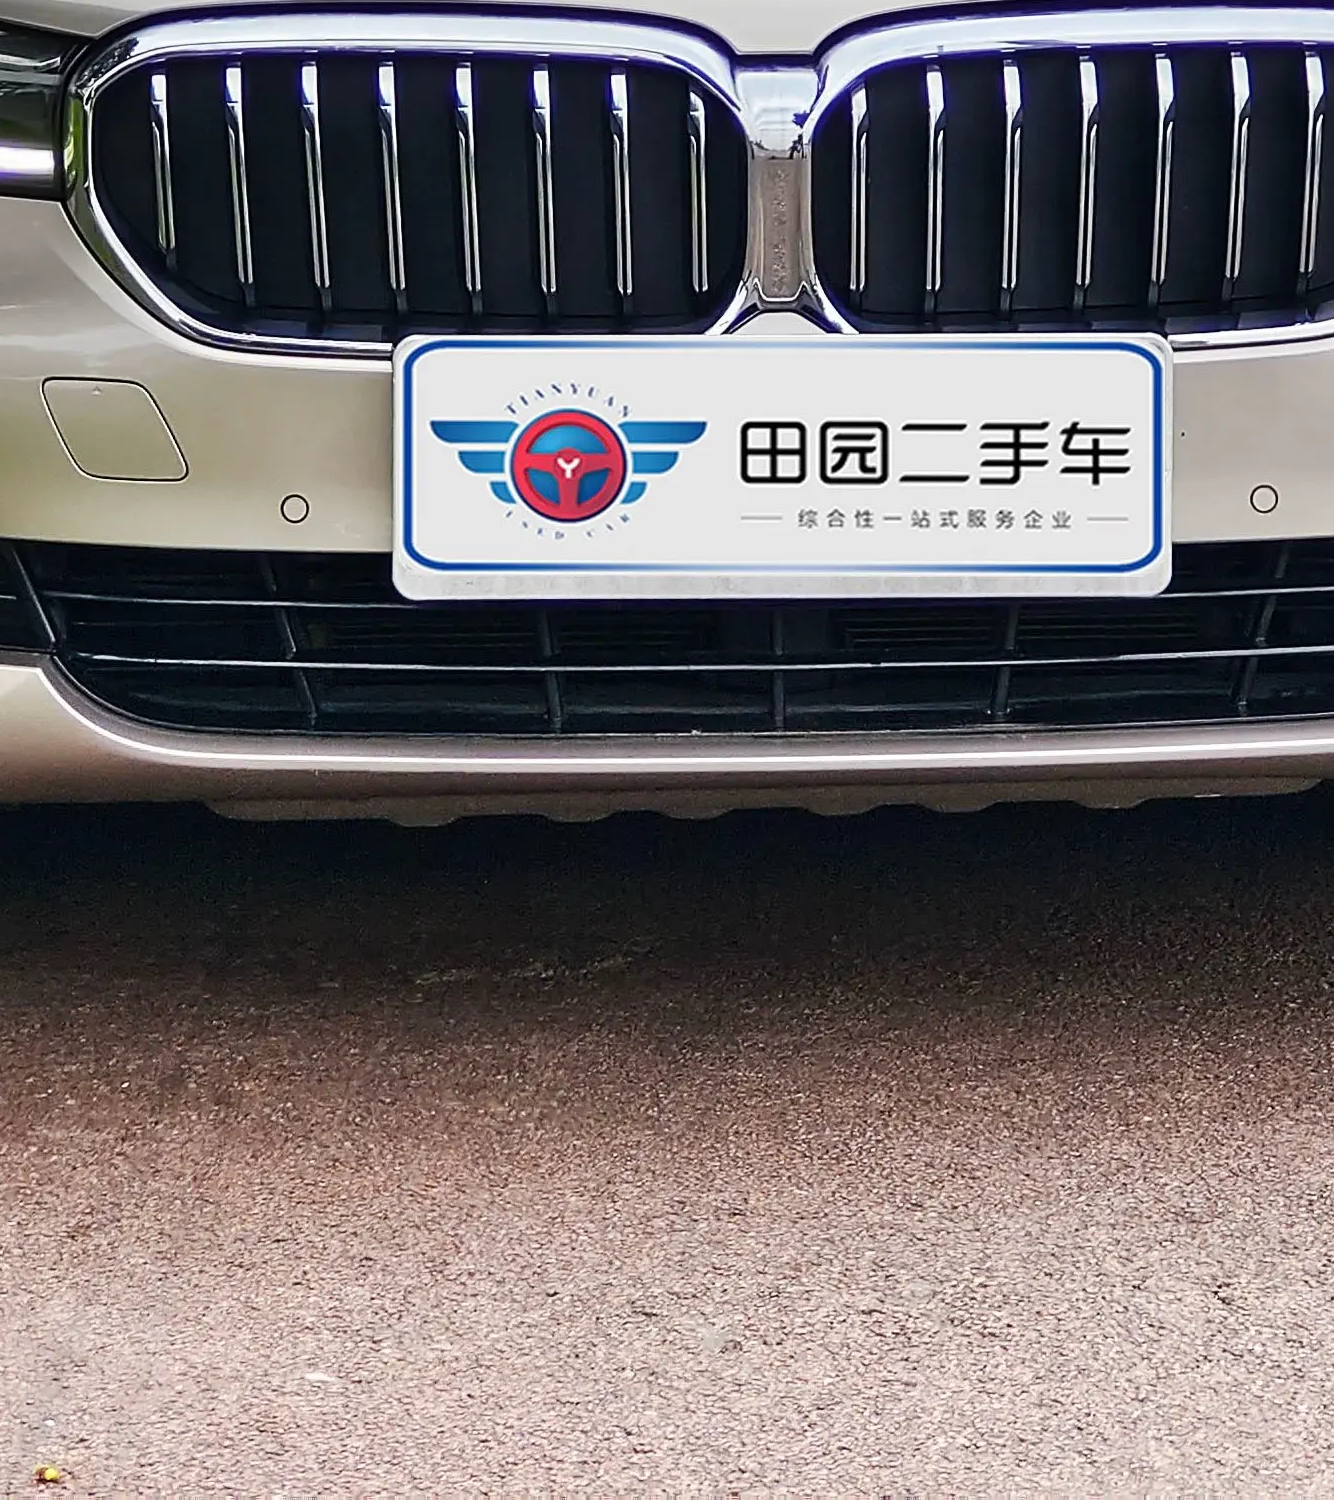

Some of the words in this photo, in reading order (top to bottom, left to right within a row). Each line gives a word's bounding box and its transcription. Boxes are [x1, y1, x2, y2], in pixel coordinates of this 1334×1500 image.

[740, 421, 1132, 486] 田园二手车
[797, 509, 1072, 530] 综合性一站式服务企业
